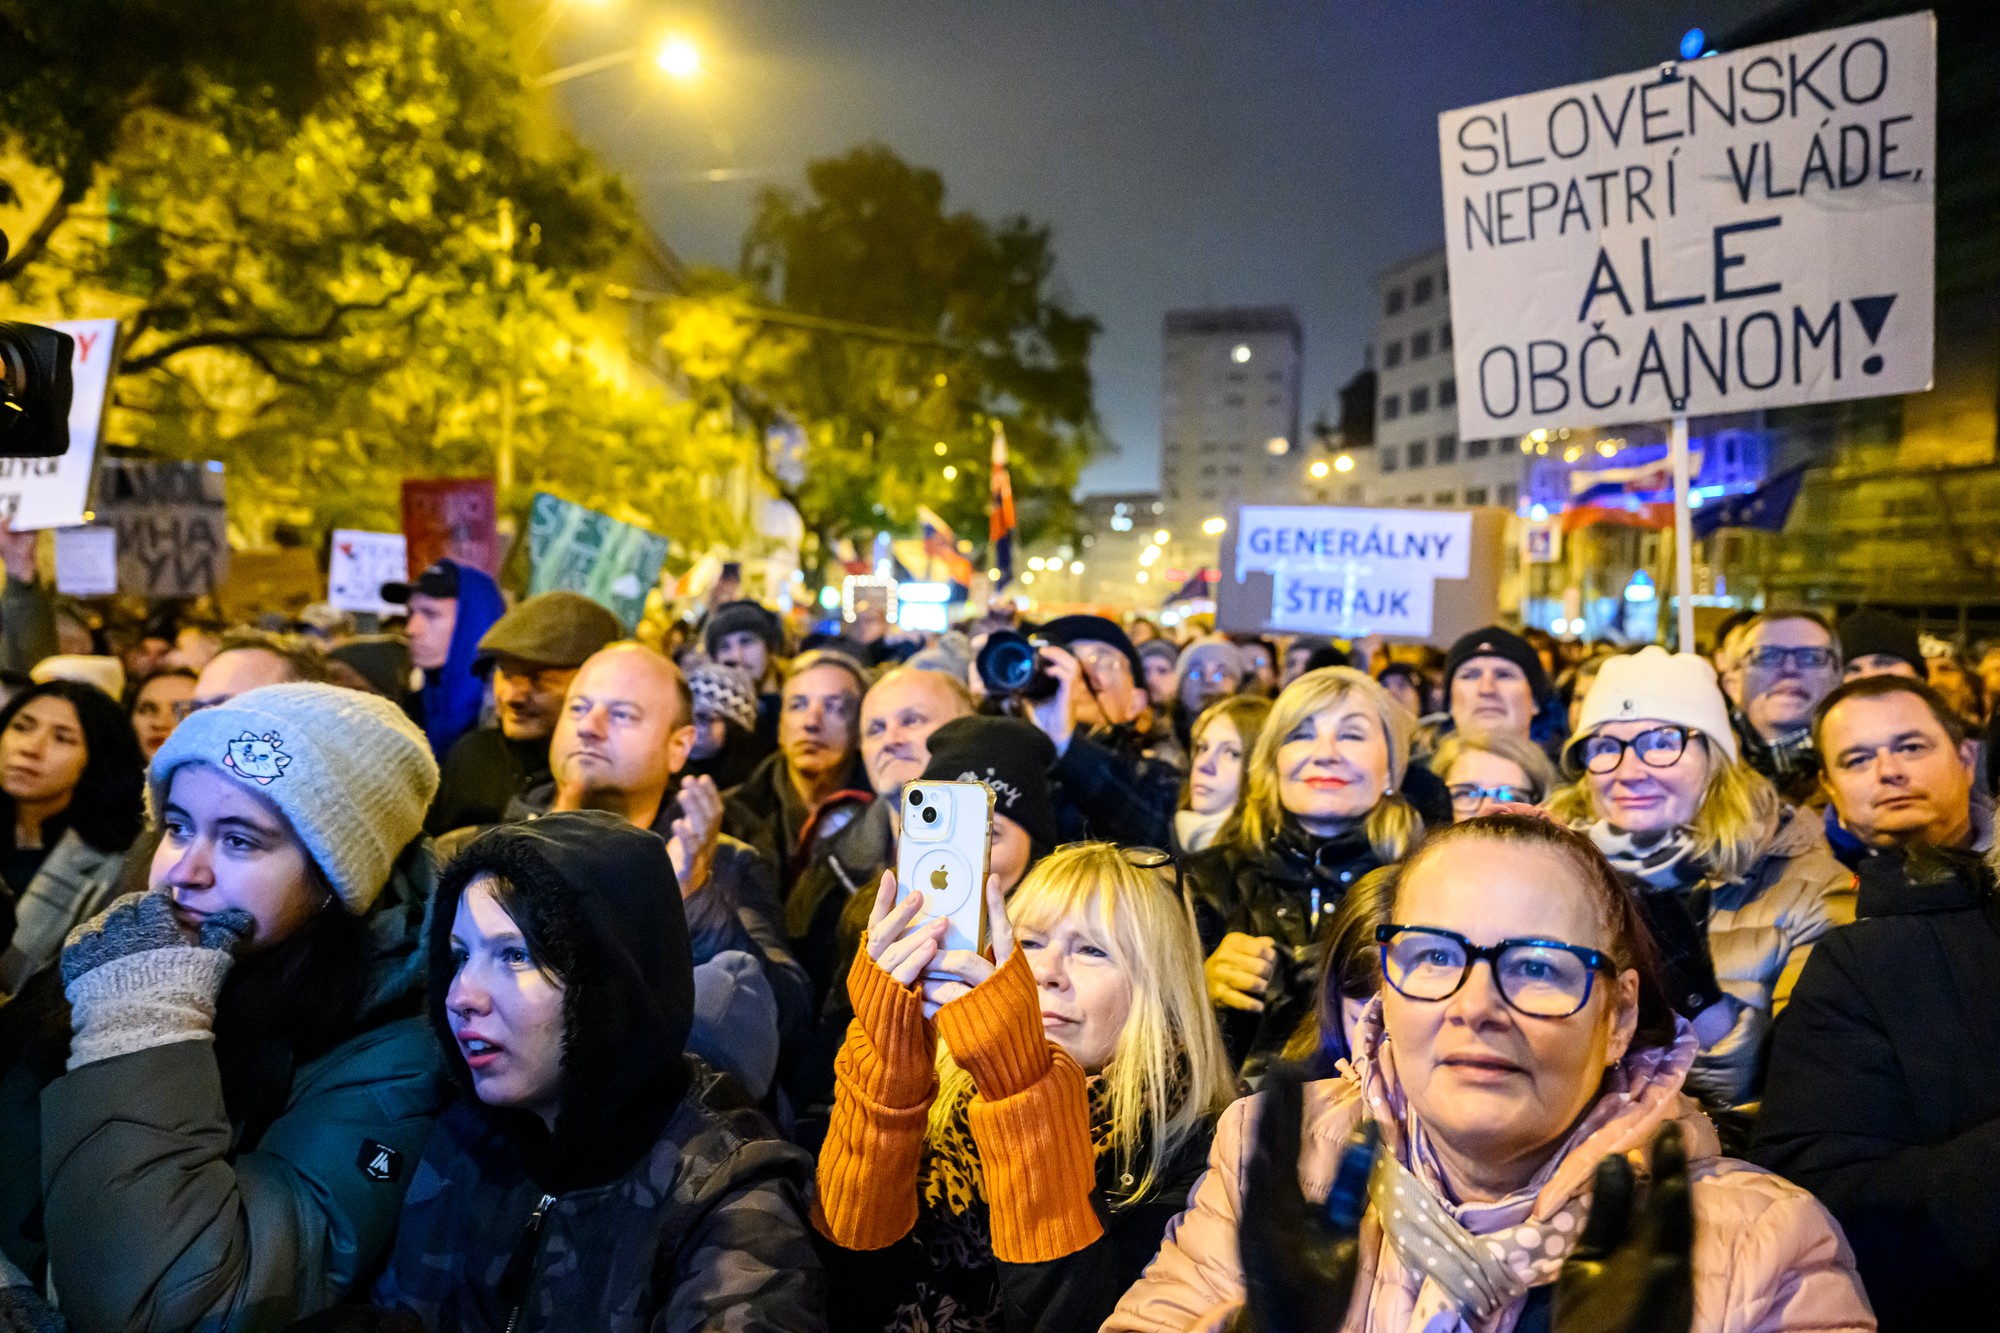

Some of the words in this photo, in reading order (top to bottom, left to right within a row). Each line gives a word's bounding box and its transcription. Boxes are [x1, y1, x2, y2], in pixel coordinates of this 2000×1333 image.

[1457, 37, 1890, 176] SLOVENSKO
[1463, 147, 1681, 250] NEPATRÍ
[1727, 115, 1923, 204] VLÁDE,
[1578, 215, 1783, 322] ALE
[1479, 293, 1899, 419] OBČANOM!
[1249, 522, 1453, 560] GENERÁLNY
[1285, 576, 1410, 619] ŠTRAJK
